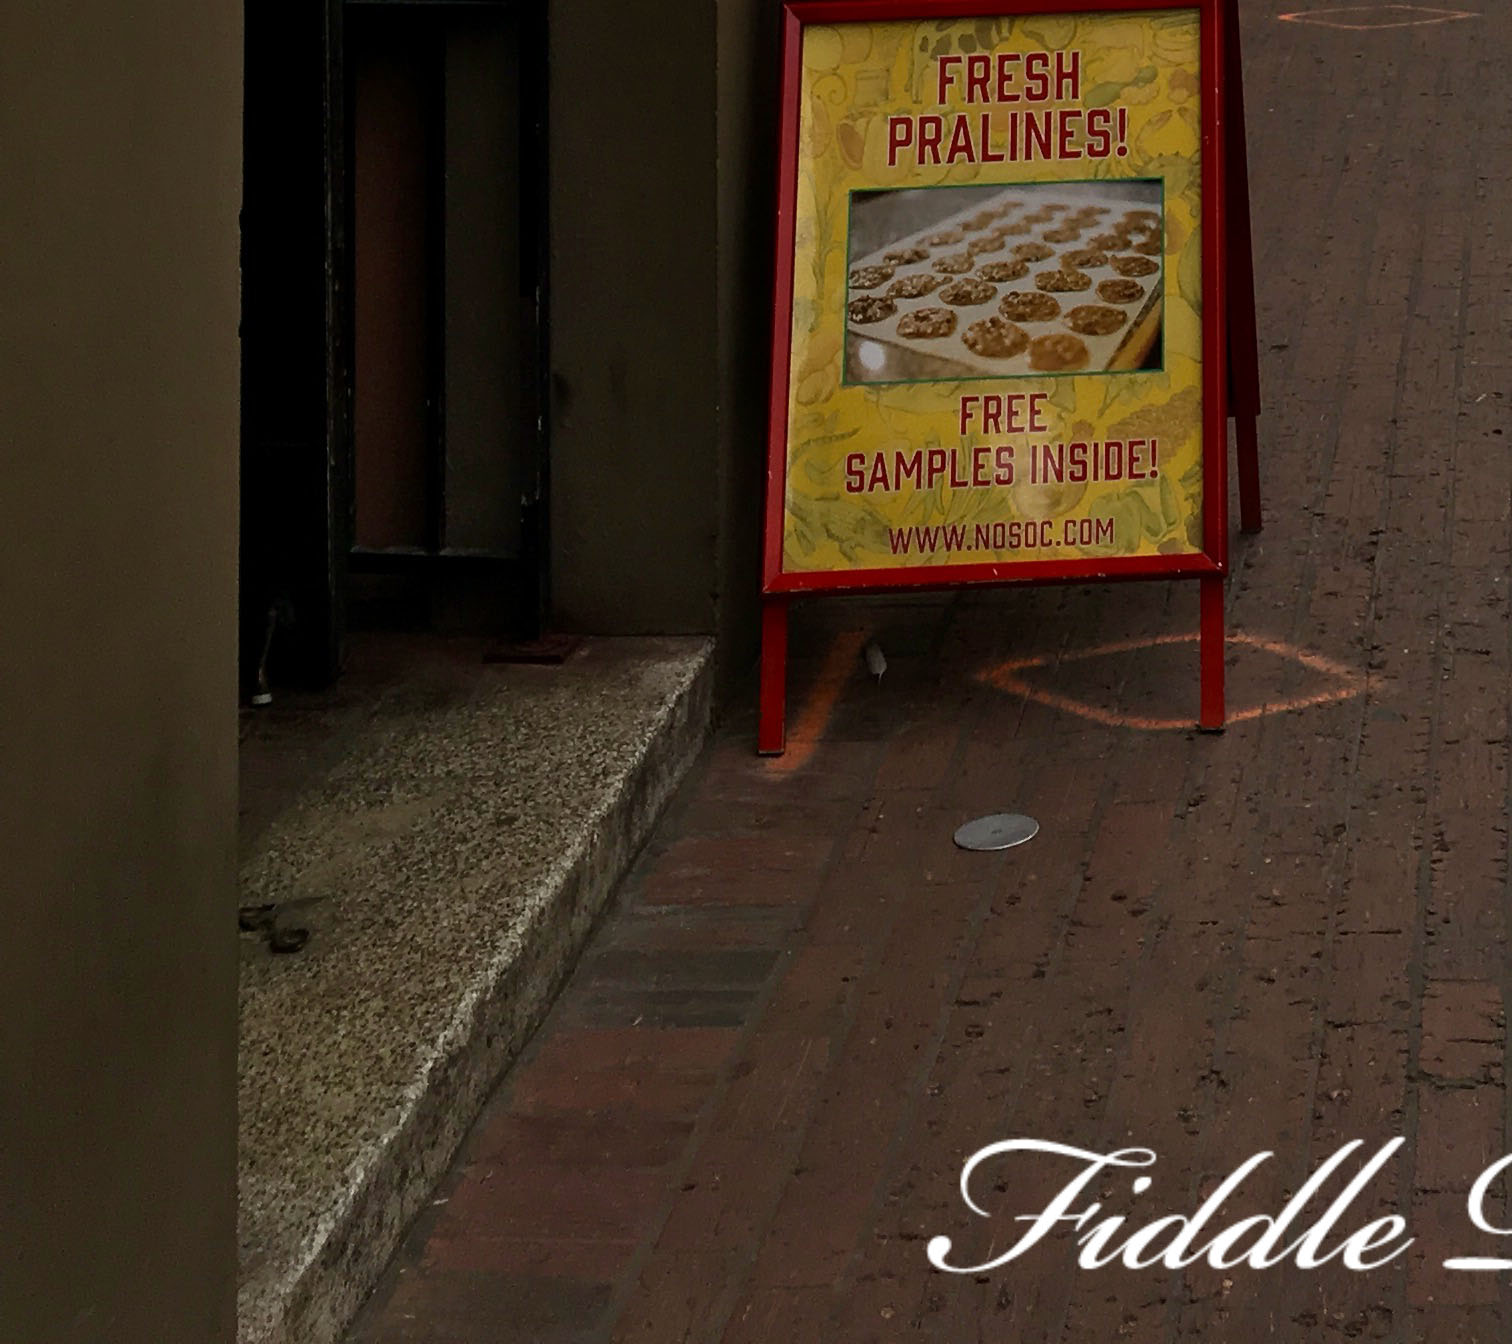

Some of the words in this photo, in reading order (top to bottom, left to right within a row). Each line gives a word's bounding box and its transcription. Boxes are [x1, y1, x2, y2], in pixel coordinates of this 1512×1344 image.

[937, 50, 1081, 105] FRESH
[887, 108, 1128, 167] PRALINES!
[959, 393, 1049, 436] FREE
[844, 446, 1014, 494] SAMPLES
[1029, 439, 1159, 486] INSIDE!
[888, 518, 1116, 554] WWW.NOSOC.COM
